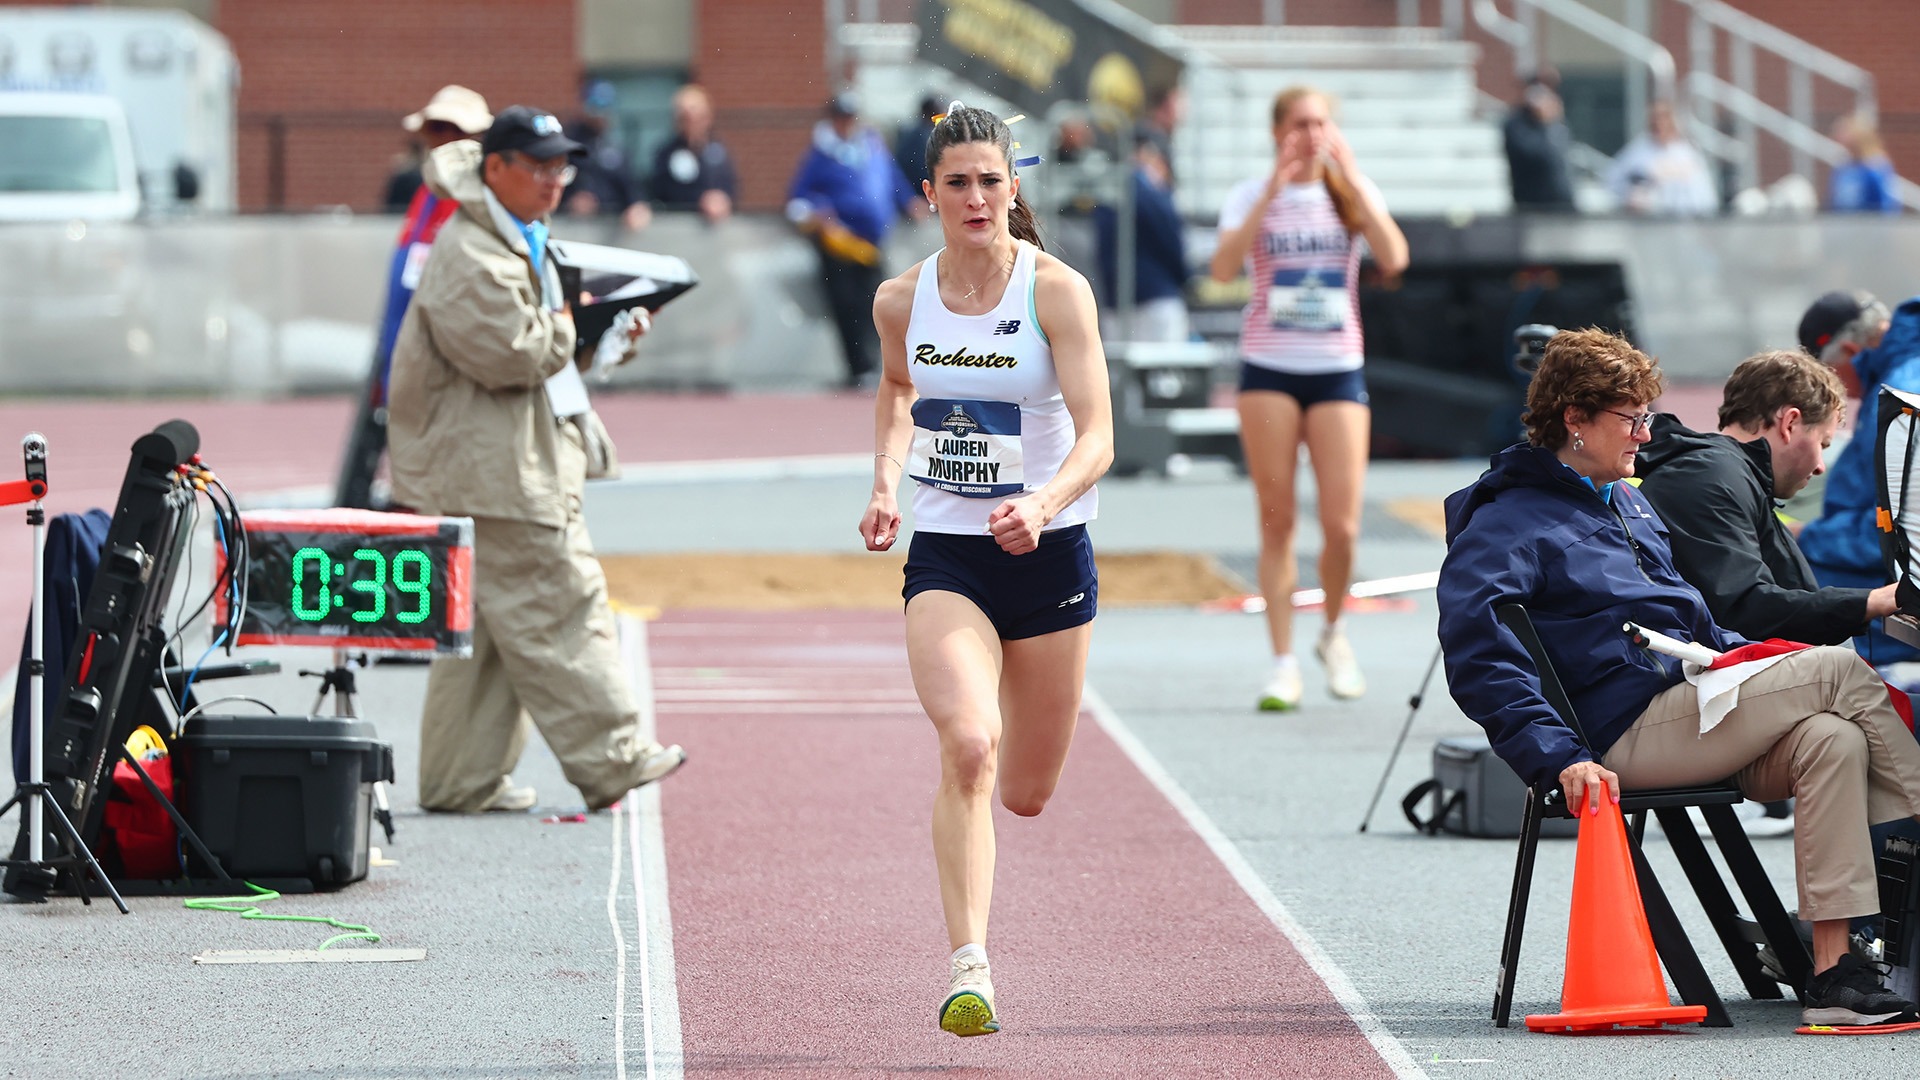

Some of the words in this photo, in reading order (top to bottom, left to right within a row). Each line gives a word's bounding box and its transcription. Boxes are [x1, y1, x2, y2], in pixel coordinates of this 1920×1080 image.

[913, 343, 1018, 369] Rochester
[934, 438, 988, 457] LAUREN
[927, 457, 1000, 483] MURPHY
[961, 486, 992, 494] WISCONSIN
[292, 548, 431, 624] 0:39
